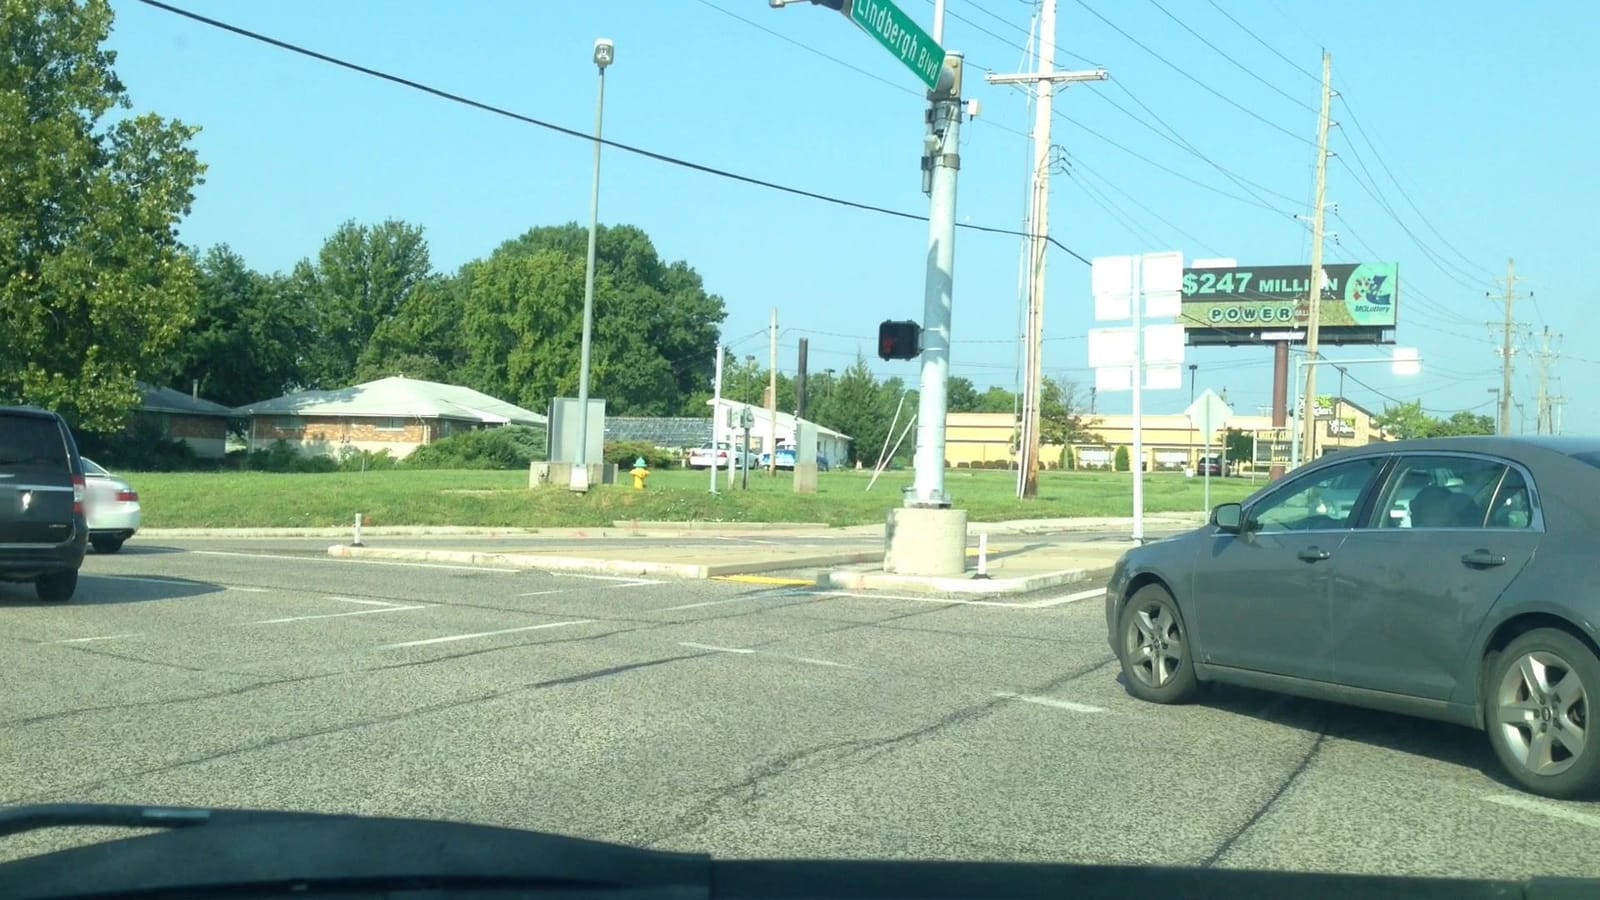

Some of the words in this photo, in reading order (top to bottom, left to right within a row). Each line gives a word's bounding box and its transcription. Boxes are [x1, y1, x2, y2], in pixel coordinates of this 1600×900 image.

[857, 0, 918, 62] Lindbergh
[917, 47, 940, 81] Blvd
[1183, 272, 1253, 296] $247
[1258, 278, 1339, 293] MILLIN
